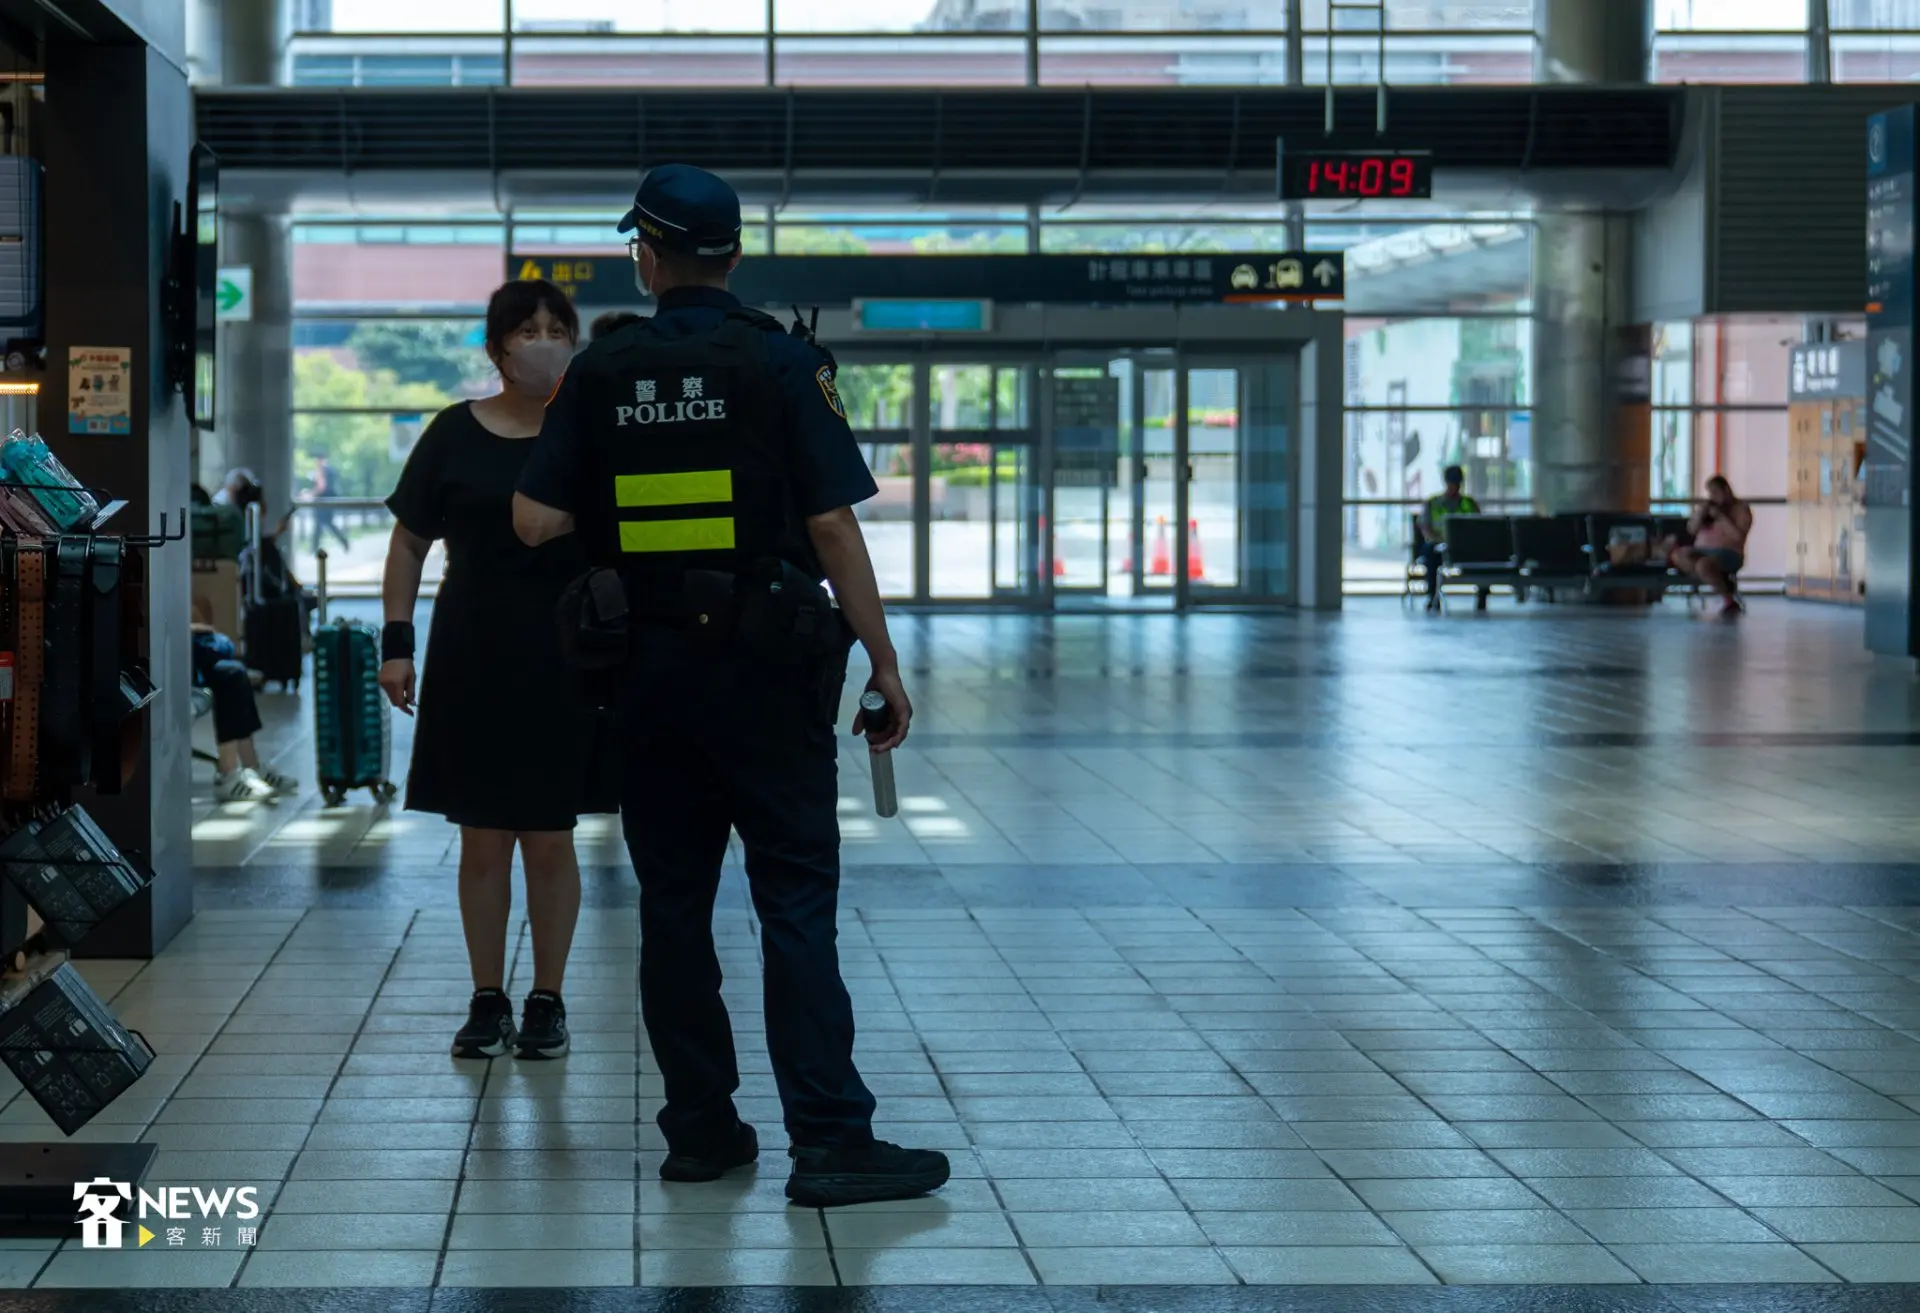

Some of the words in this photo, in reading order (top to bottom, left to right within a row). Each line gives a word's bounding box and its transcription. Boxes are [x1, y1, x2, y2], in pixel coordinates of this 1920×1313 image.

[1308, 158, 1415, 196] 14:09
[635, 376, 704, 403] 警察
[616, 399, 726, 426] POLICE
